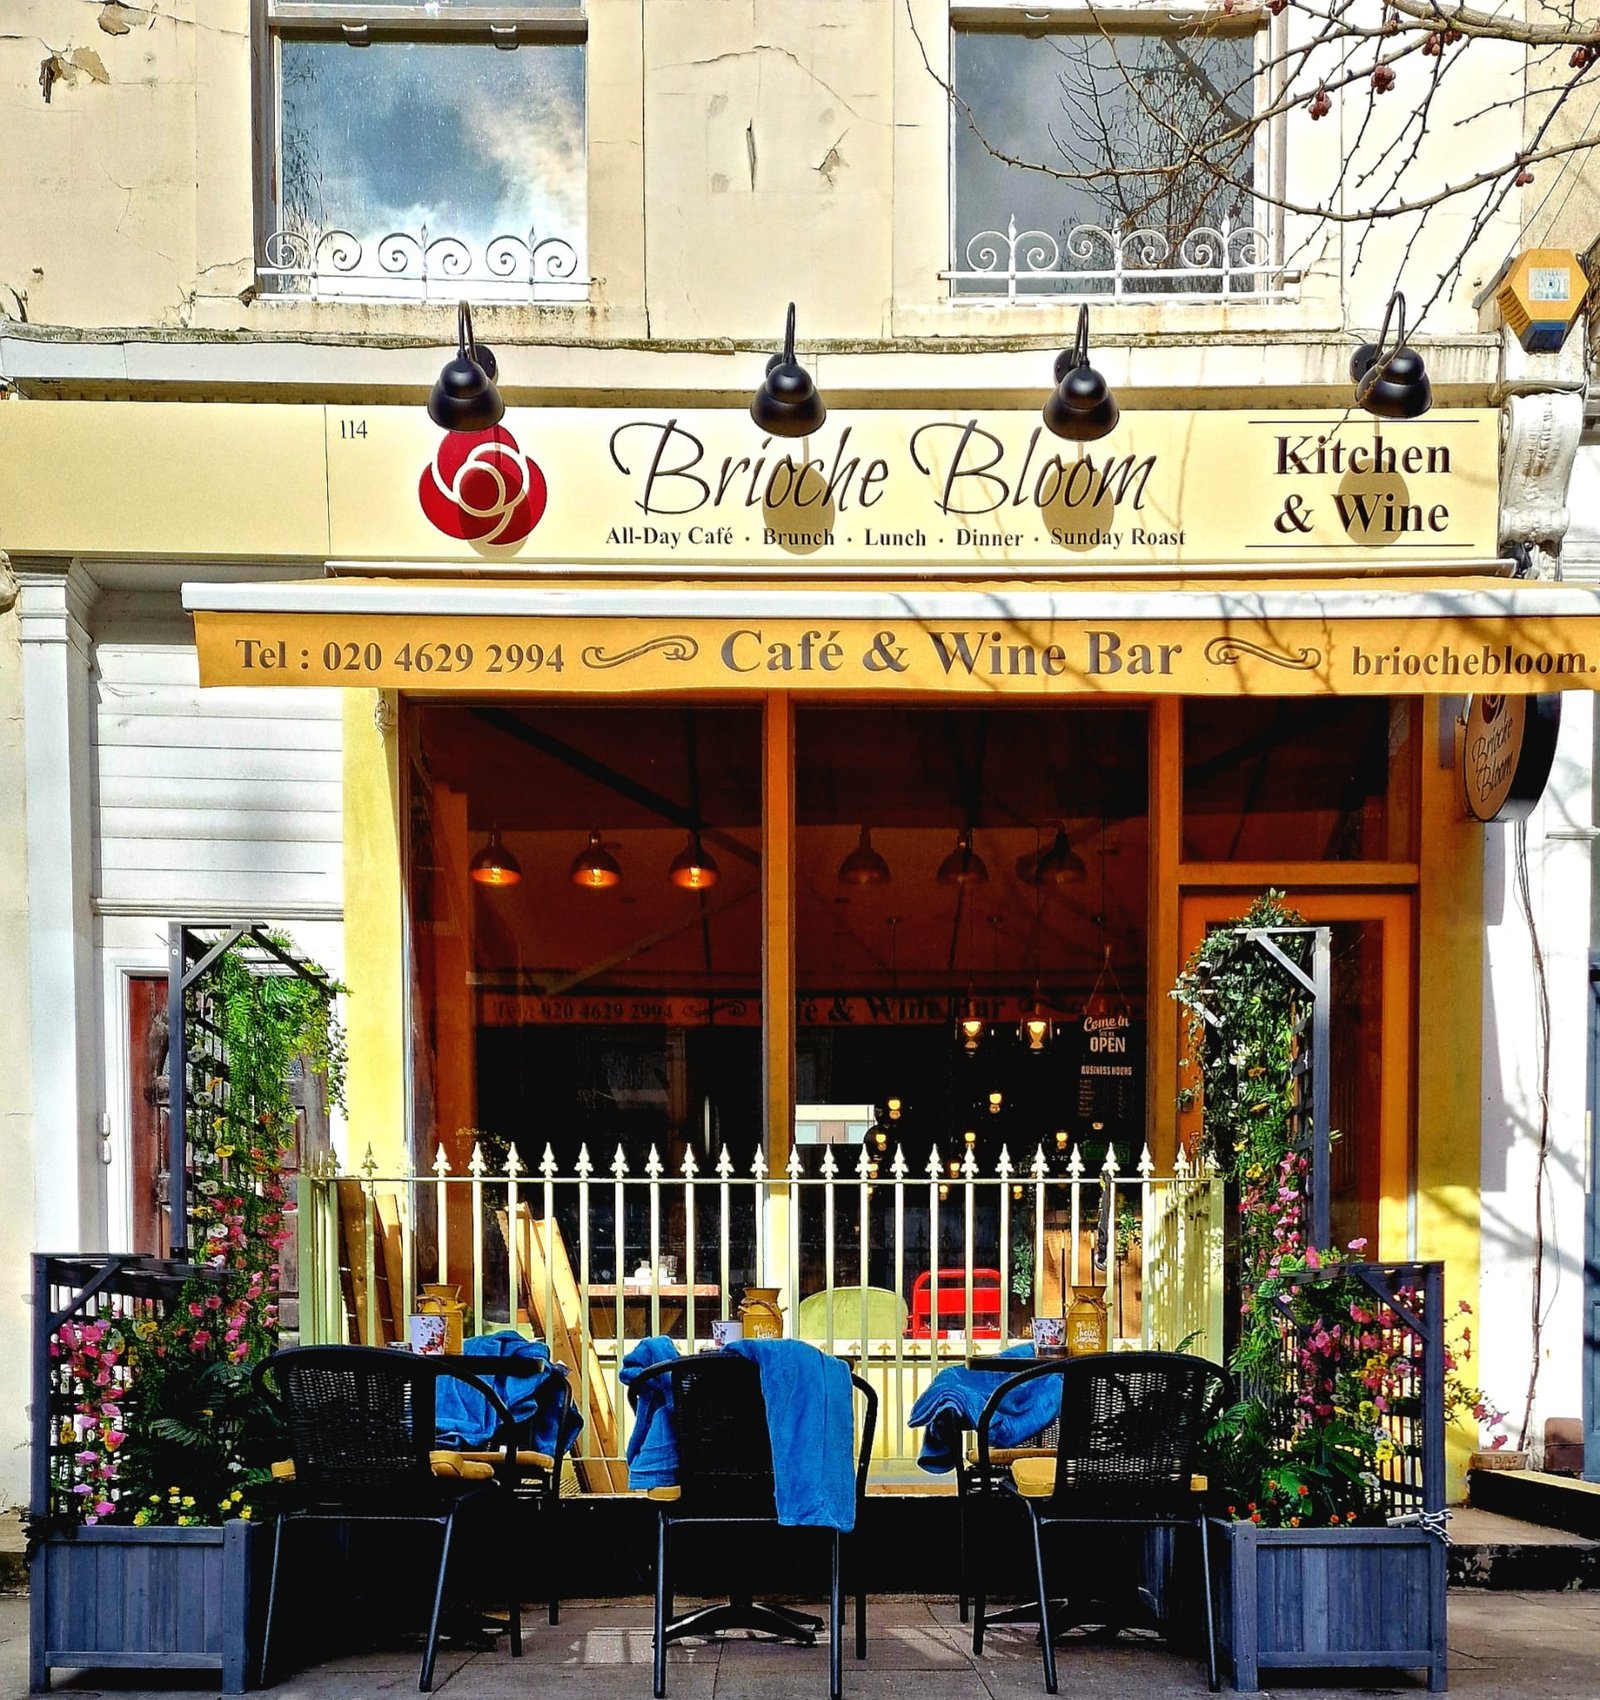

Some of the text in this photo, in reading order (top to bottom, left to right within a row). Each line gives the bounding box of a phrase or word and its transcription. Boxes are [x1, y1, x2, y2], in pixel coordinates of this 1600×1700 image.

[339, 420, 368, 439] 114
[609, 419, 1157, 516] Brioche Bloom
[1273, 435, 1452, 475] Kitchen
[1274, 493, 1449, 534] & Wine
[605, 526, 1186, 550] All-Day Café Brunch Lunch Dinner Sunday Roast
[322, 641, 382, 671] 020
[394, 642, 474, 673] 4629
[485, 643, 564, 673] 2994
[721, 628, 1183, 676] Café & Wine Bar
[1352, 645, 1597, 676] briochebloom.
[1083, 1016, 1117, 1032] Come
[1090, 1036, 1126, 1053] OPEN
[1081, 1065, 1133, 1076] BUSINESS HOURS
